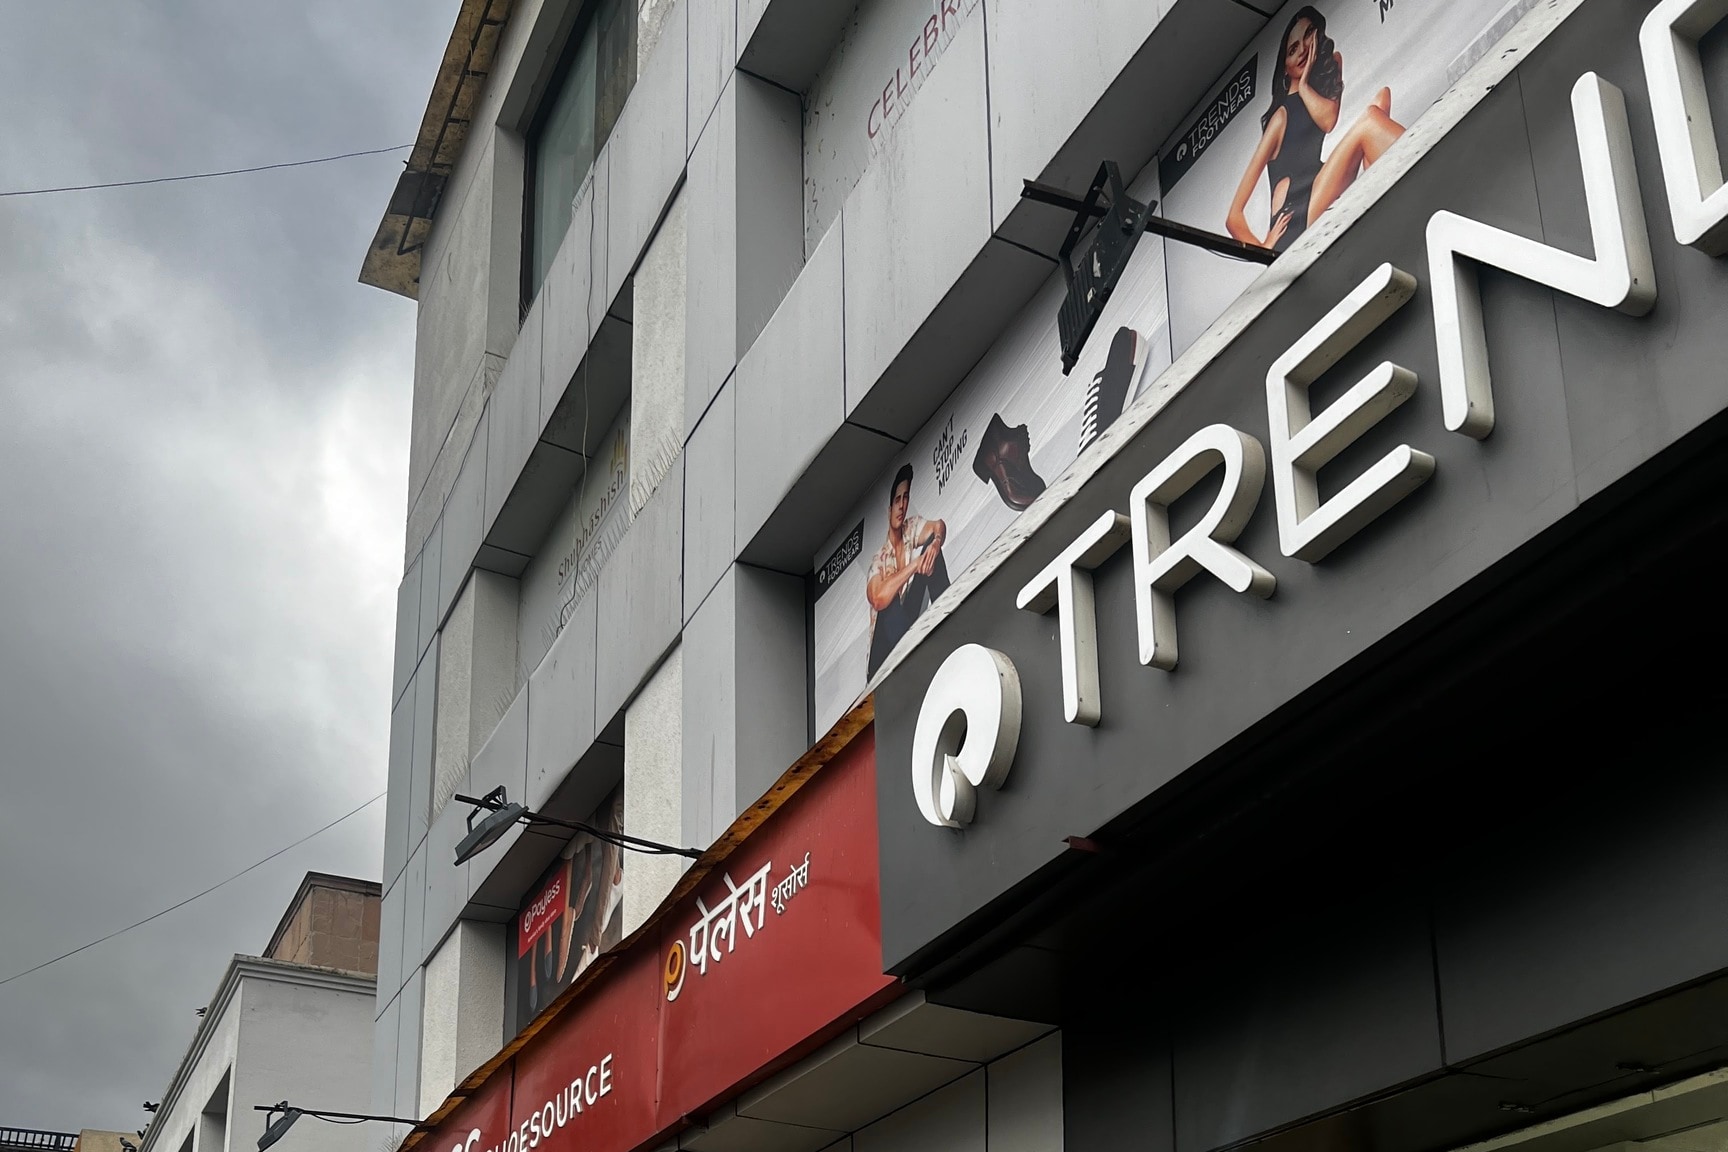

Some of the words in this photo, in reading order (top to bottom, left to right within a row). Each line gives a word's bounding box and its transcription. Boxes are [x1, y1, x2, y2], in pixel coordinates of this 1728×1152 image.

[868, 0, 961, 139] CELEBR
[1188, 70, 1251, 146] TRENDS
[1192, 86, 1252, 157] FOOTWEAR
[933, 412, 955, 465] CAN'T
[935, 435, 954, 480] STOP
[938, 428, 968, 496] MOVING
[826, 531, 859, 576] TRENDS
[828, 542, 860, 584] FOOTWEAR
[531, 879, 560, 922] Payless
[690, 861, 771, 975] पेलेस
